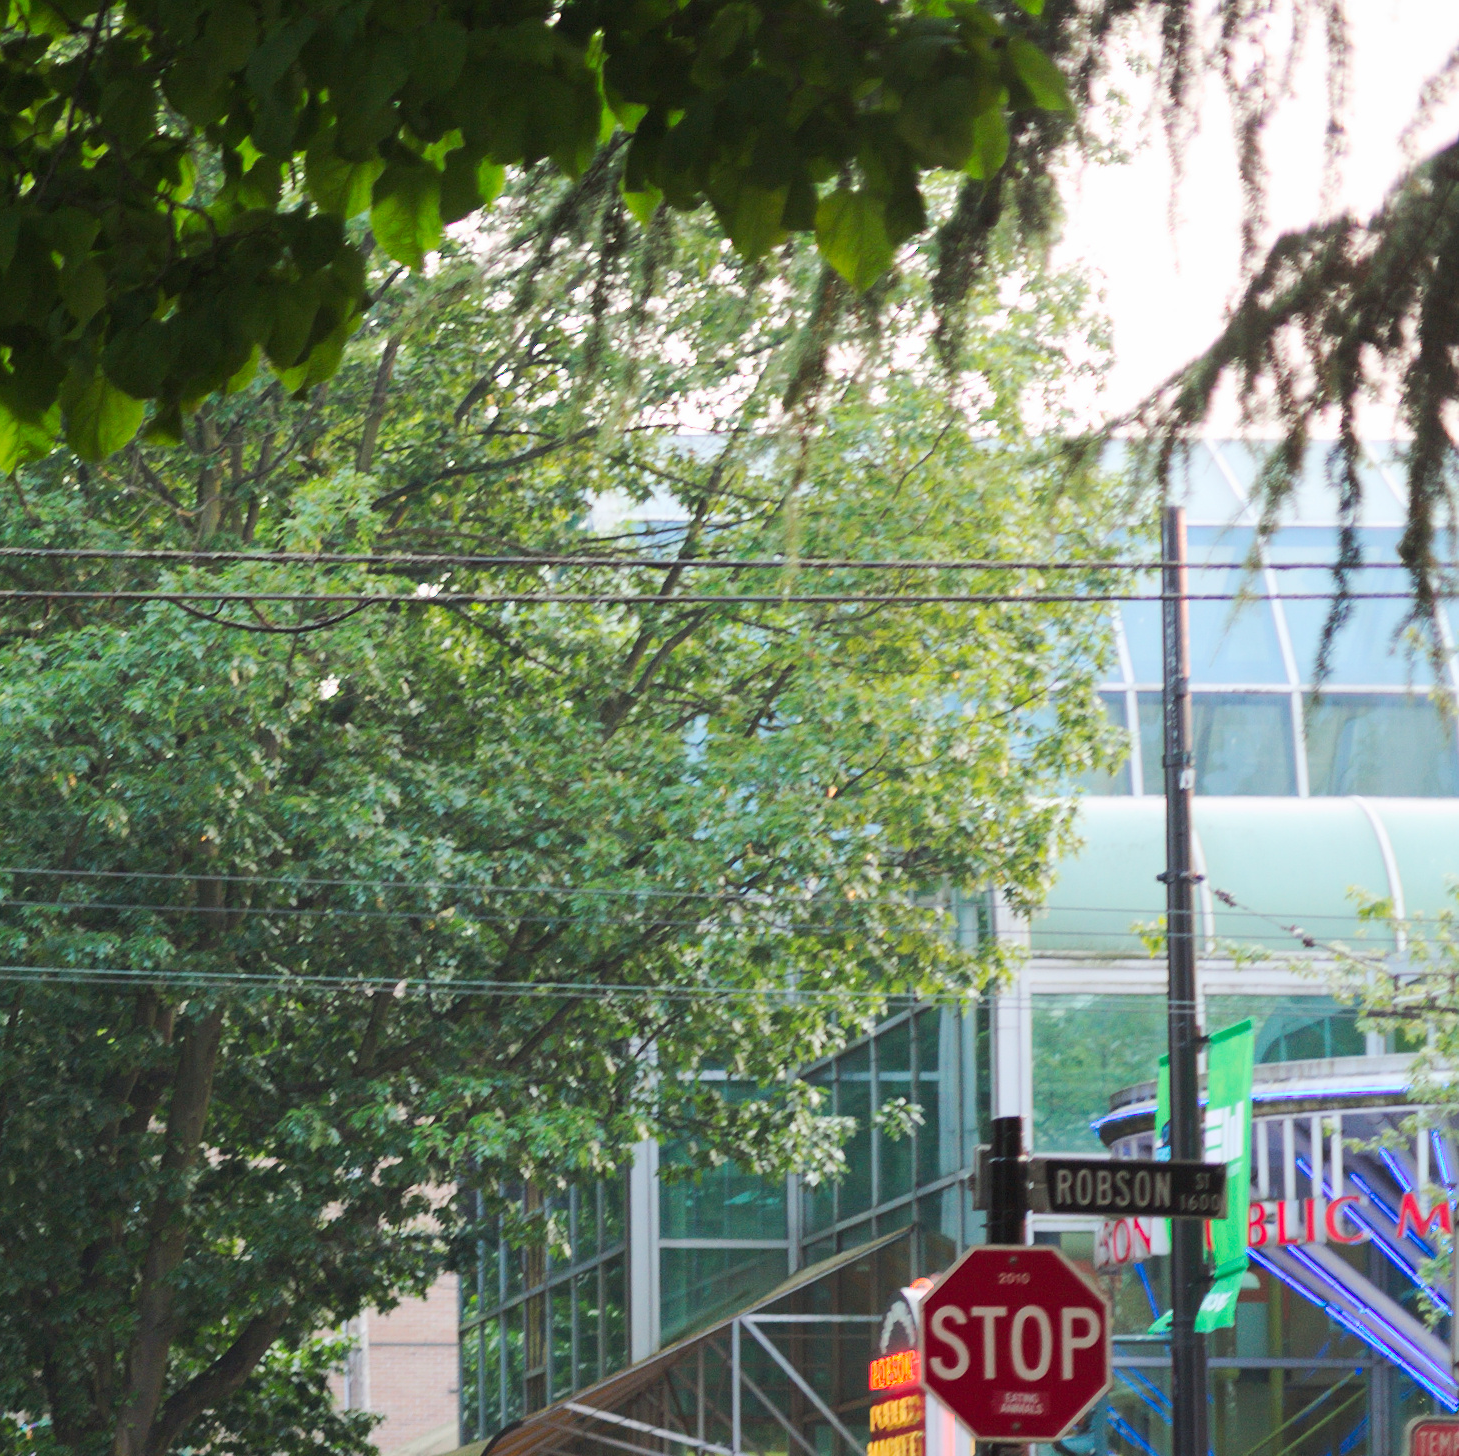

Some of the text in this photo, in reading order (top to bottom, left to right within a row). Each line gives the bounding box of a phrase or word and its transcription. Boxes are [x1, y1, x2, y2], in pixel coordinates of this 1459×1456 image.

[1056, 1168, 1210, 1207] ROBSON ST
[1180, 1193, 1221, 1211] 1600
[1205, 1196, 1367, 1248] BLIC
[998, 1272, 1030, 1285] 2010
[930, 1304, 1101, 1381] STOP
[1004, 1391, 1039, 1402] EATING
[999, 1402, 1044, 1415] ANIMALS
[1419, 1431, 1459, 1456] TEMP
